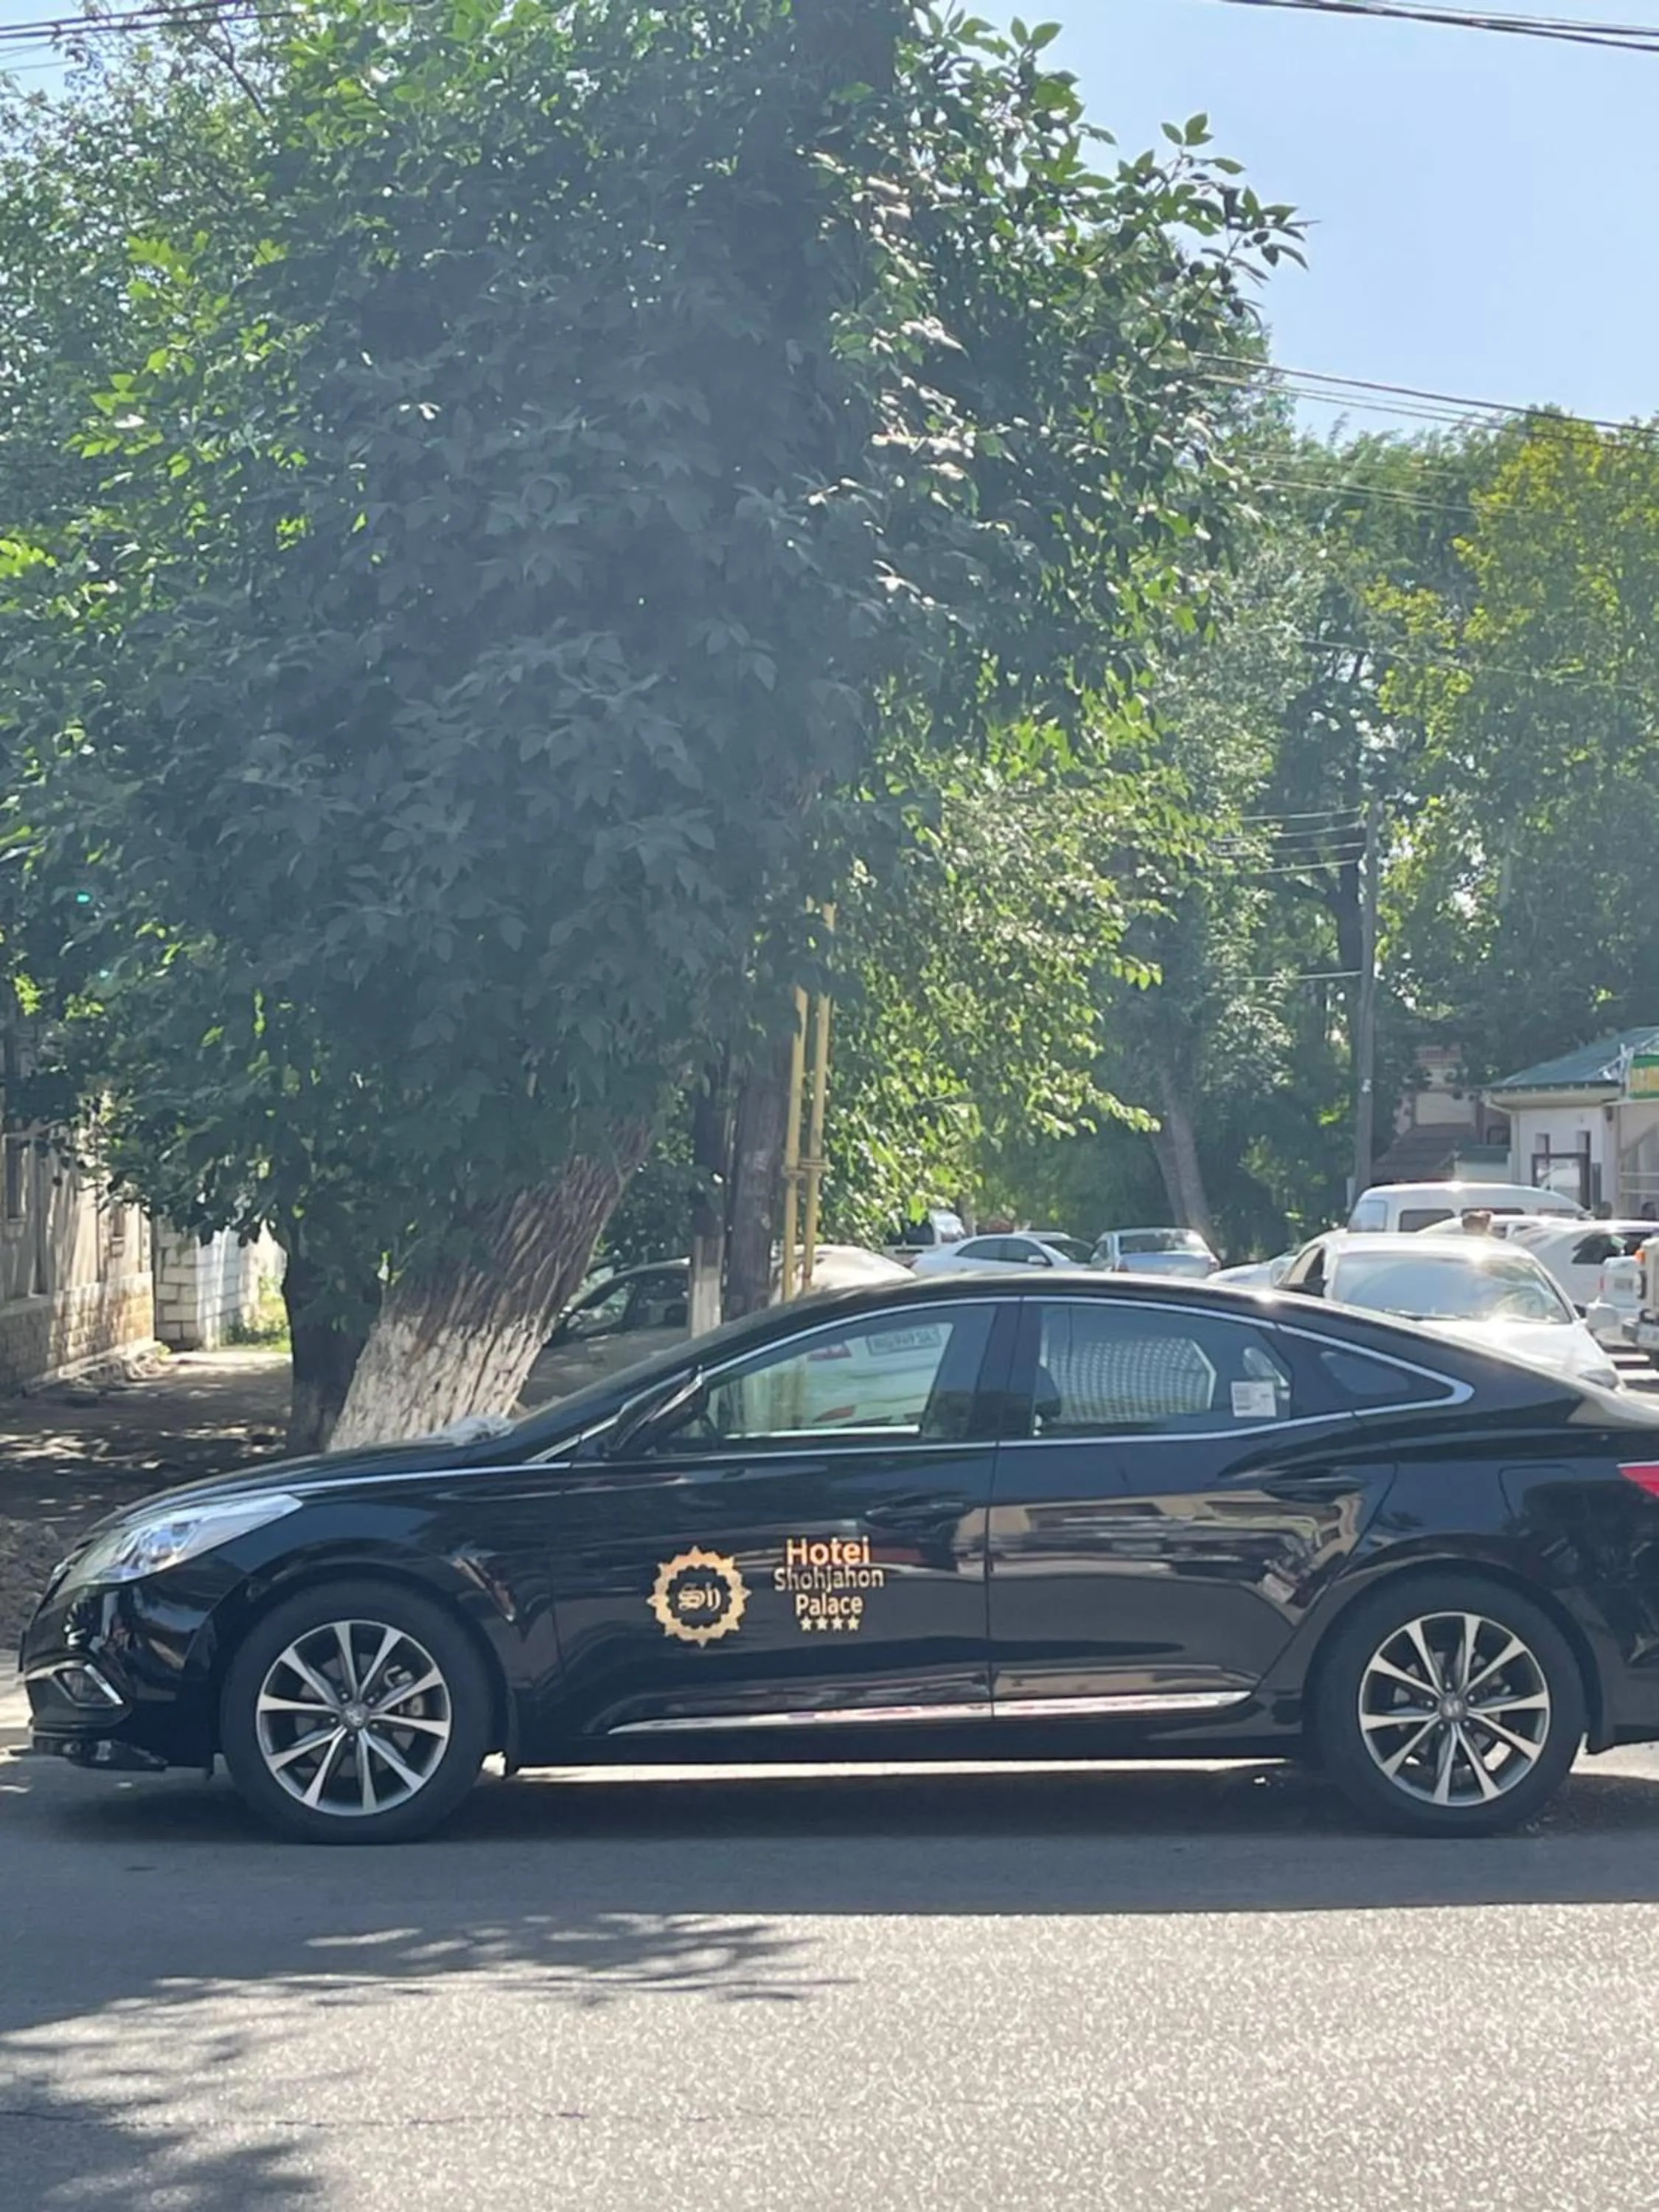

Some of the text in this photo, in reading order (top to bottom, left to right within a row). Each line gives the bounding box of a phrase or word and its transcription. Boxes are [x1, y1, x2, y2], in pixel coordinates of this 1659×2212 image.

[786, 1536, 869, 1565] Hotel
[773, 1565, 884, 1592] Shohjahon
[796, 1593, 863, 1617] Palace
